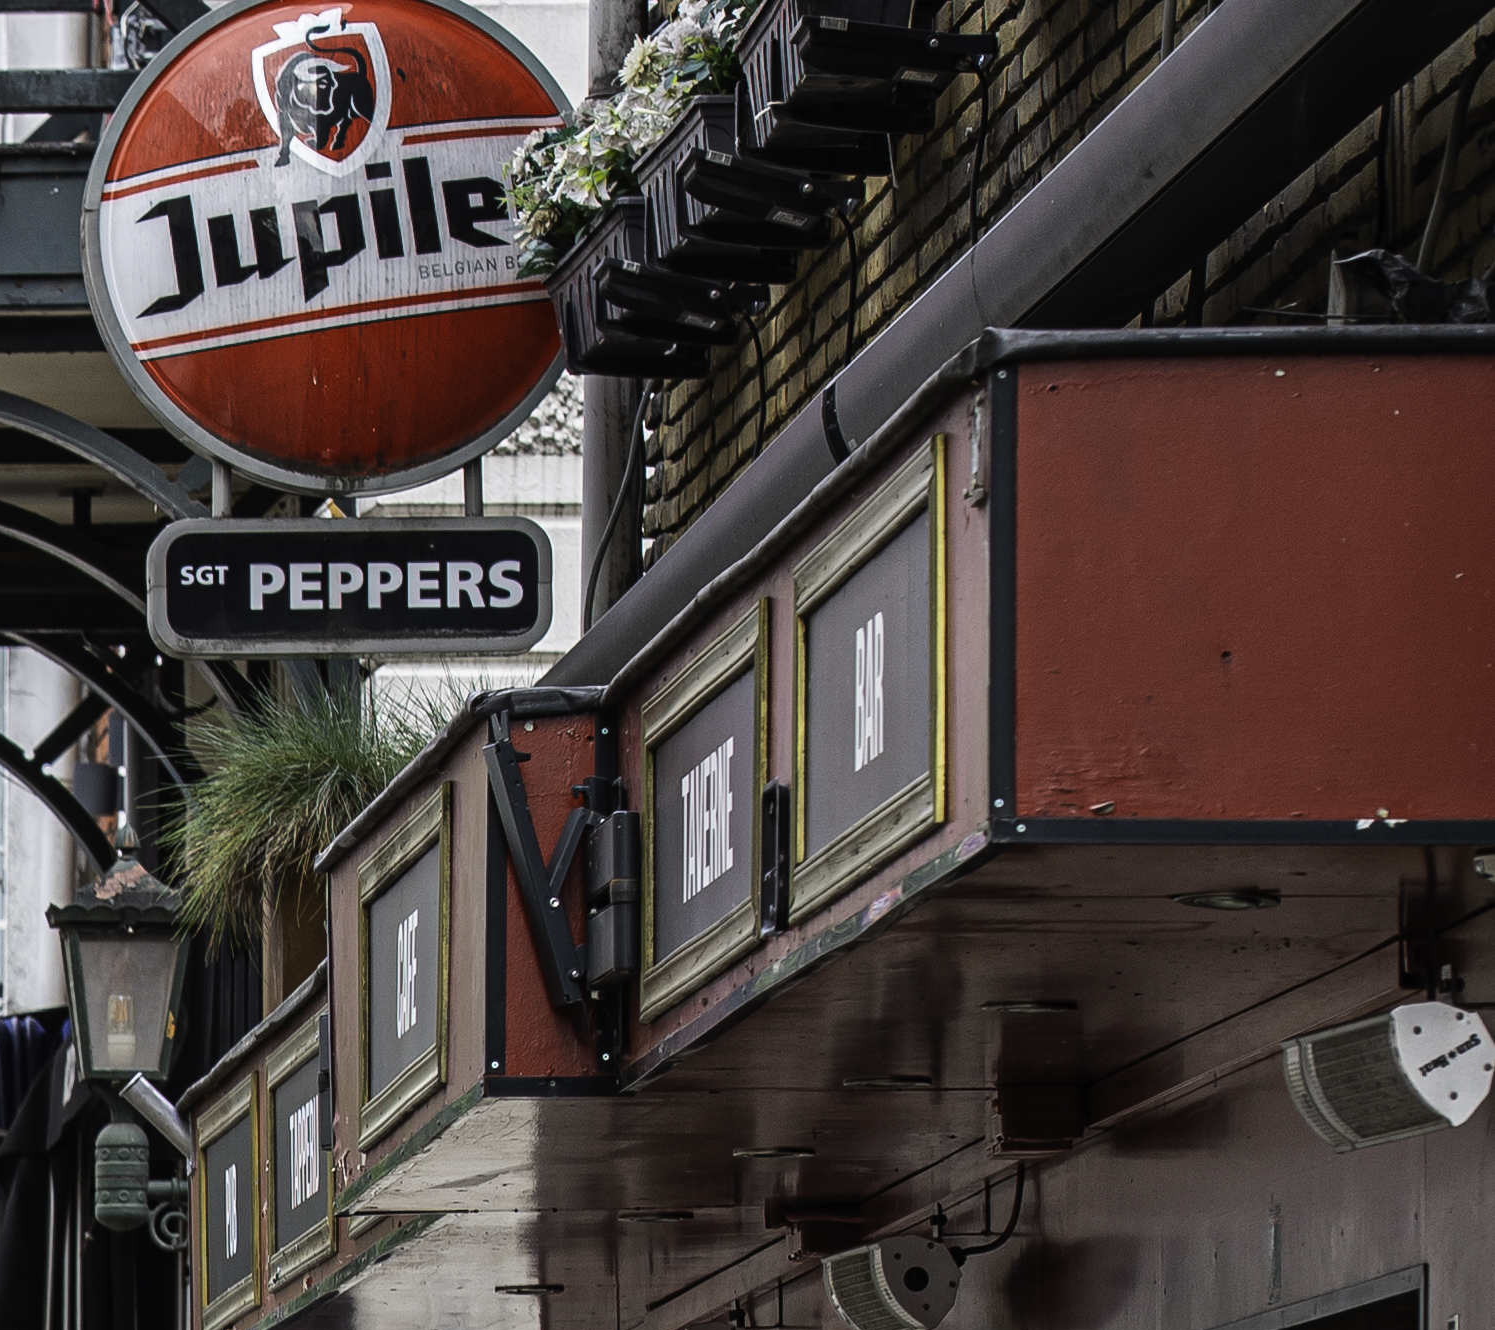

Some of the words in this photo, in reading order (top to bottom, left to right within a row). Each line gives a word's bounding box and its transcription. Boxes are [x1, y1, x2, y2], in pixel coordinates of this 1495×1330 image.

[135, 156, 519, 319] Jupile
[418, 257, 498, 280] BELGIAN
[180, 565, 229, 586] SGT
[249, 559, 525, 611] PEPPERS
[854, 611, 884, 773] BAR
[681, 736, 734, 904] TAVERNE
